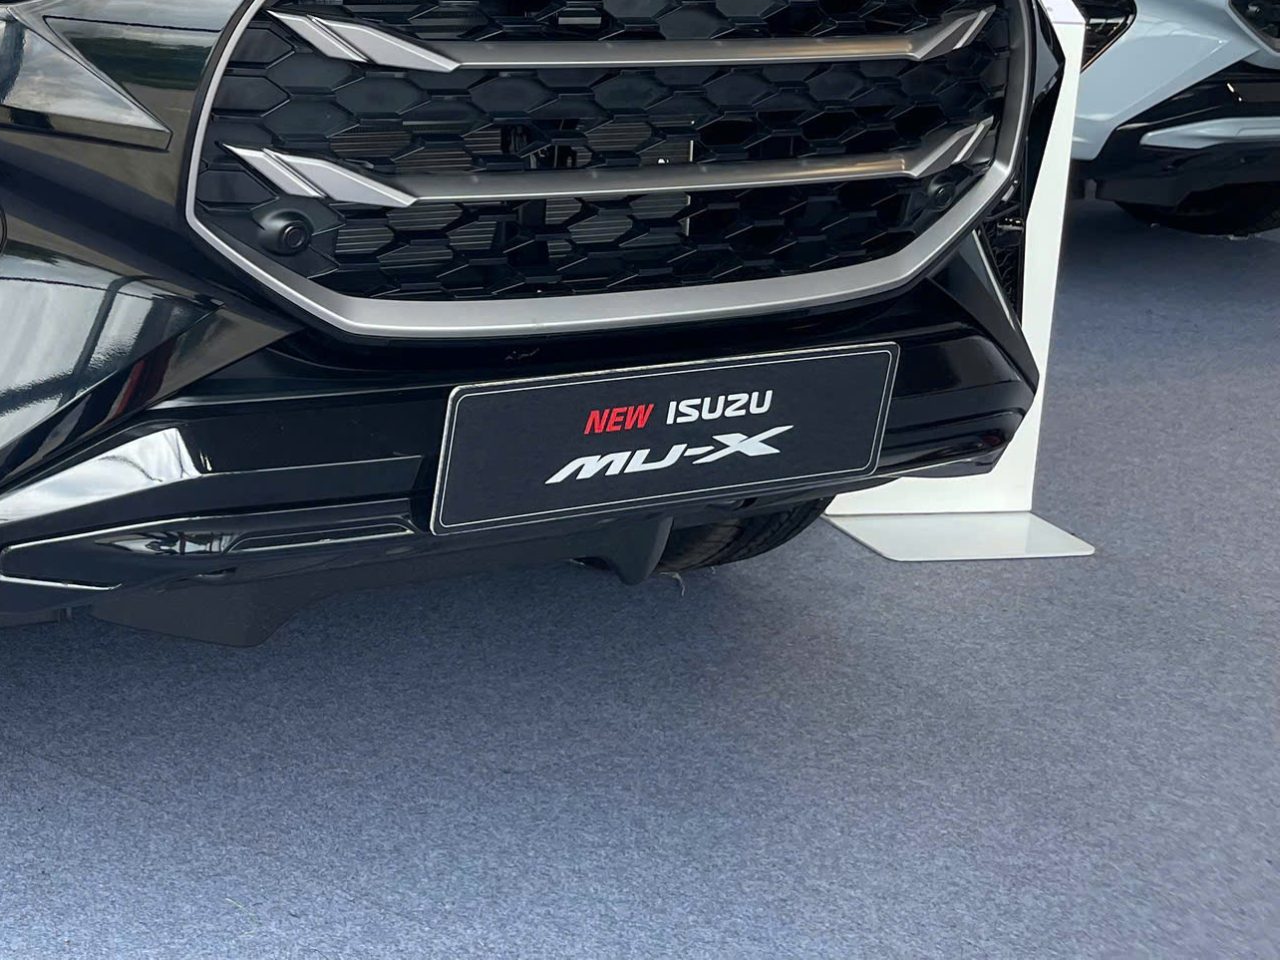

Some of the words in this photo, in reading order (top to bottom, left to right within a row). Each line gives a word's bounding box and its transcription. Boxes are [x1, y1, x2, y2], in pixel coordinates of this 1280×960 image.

[583, 403, 655, 436] NEW
[666, 389, 774, 426] ISUZU
[544, 424, 795, 485] MU-X
